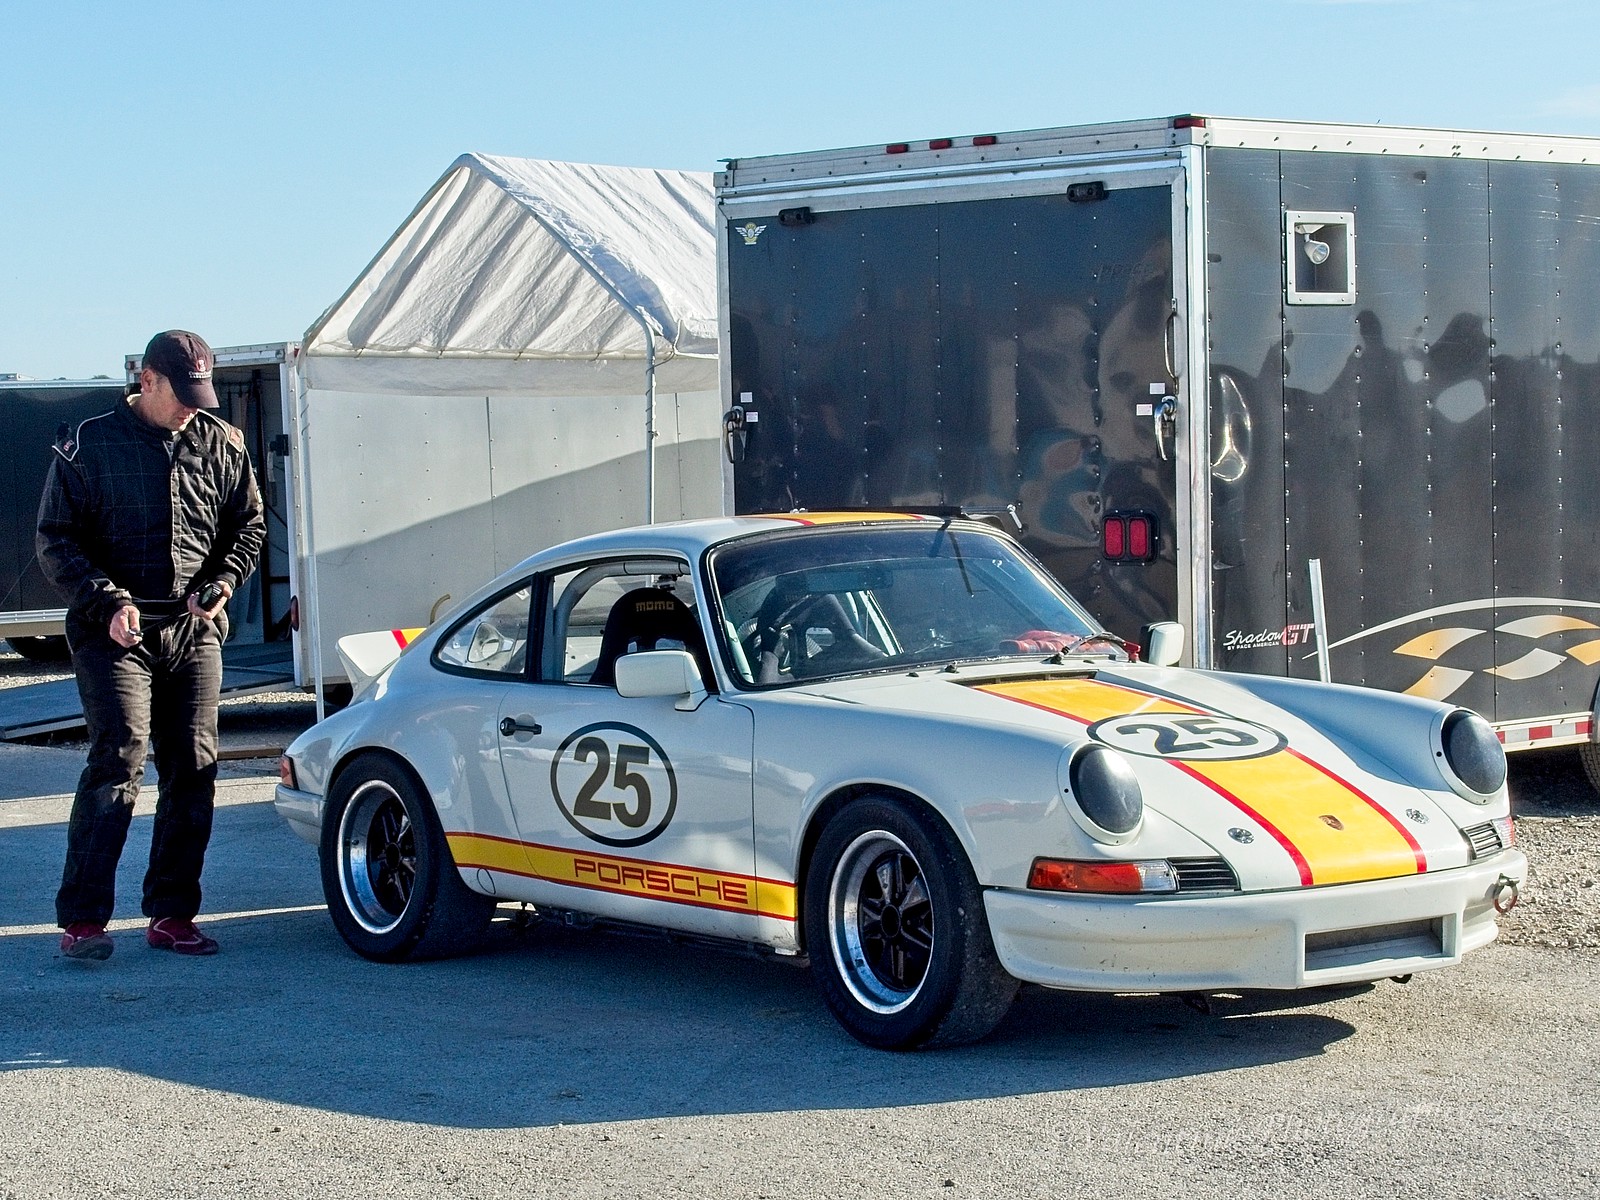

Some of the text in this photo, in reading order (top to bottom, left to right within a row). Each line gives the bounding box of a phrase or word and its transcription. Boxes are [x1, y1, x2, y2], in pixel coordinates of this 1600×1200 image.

[1223, 623, 1315, 646] Shadow GT
[1115, 718, 1259, 755] 25
[573, 736, 652, 828] 25
[573, 857, 749, 905] PORSCHE
